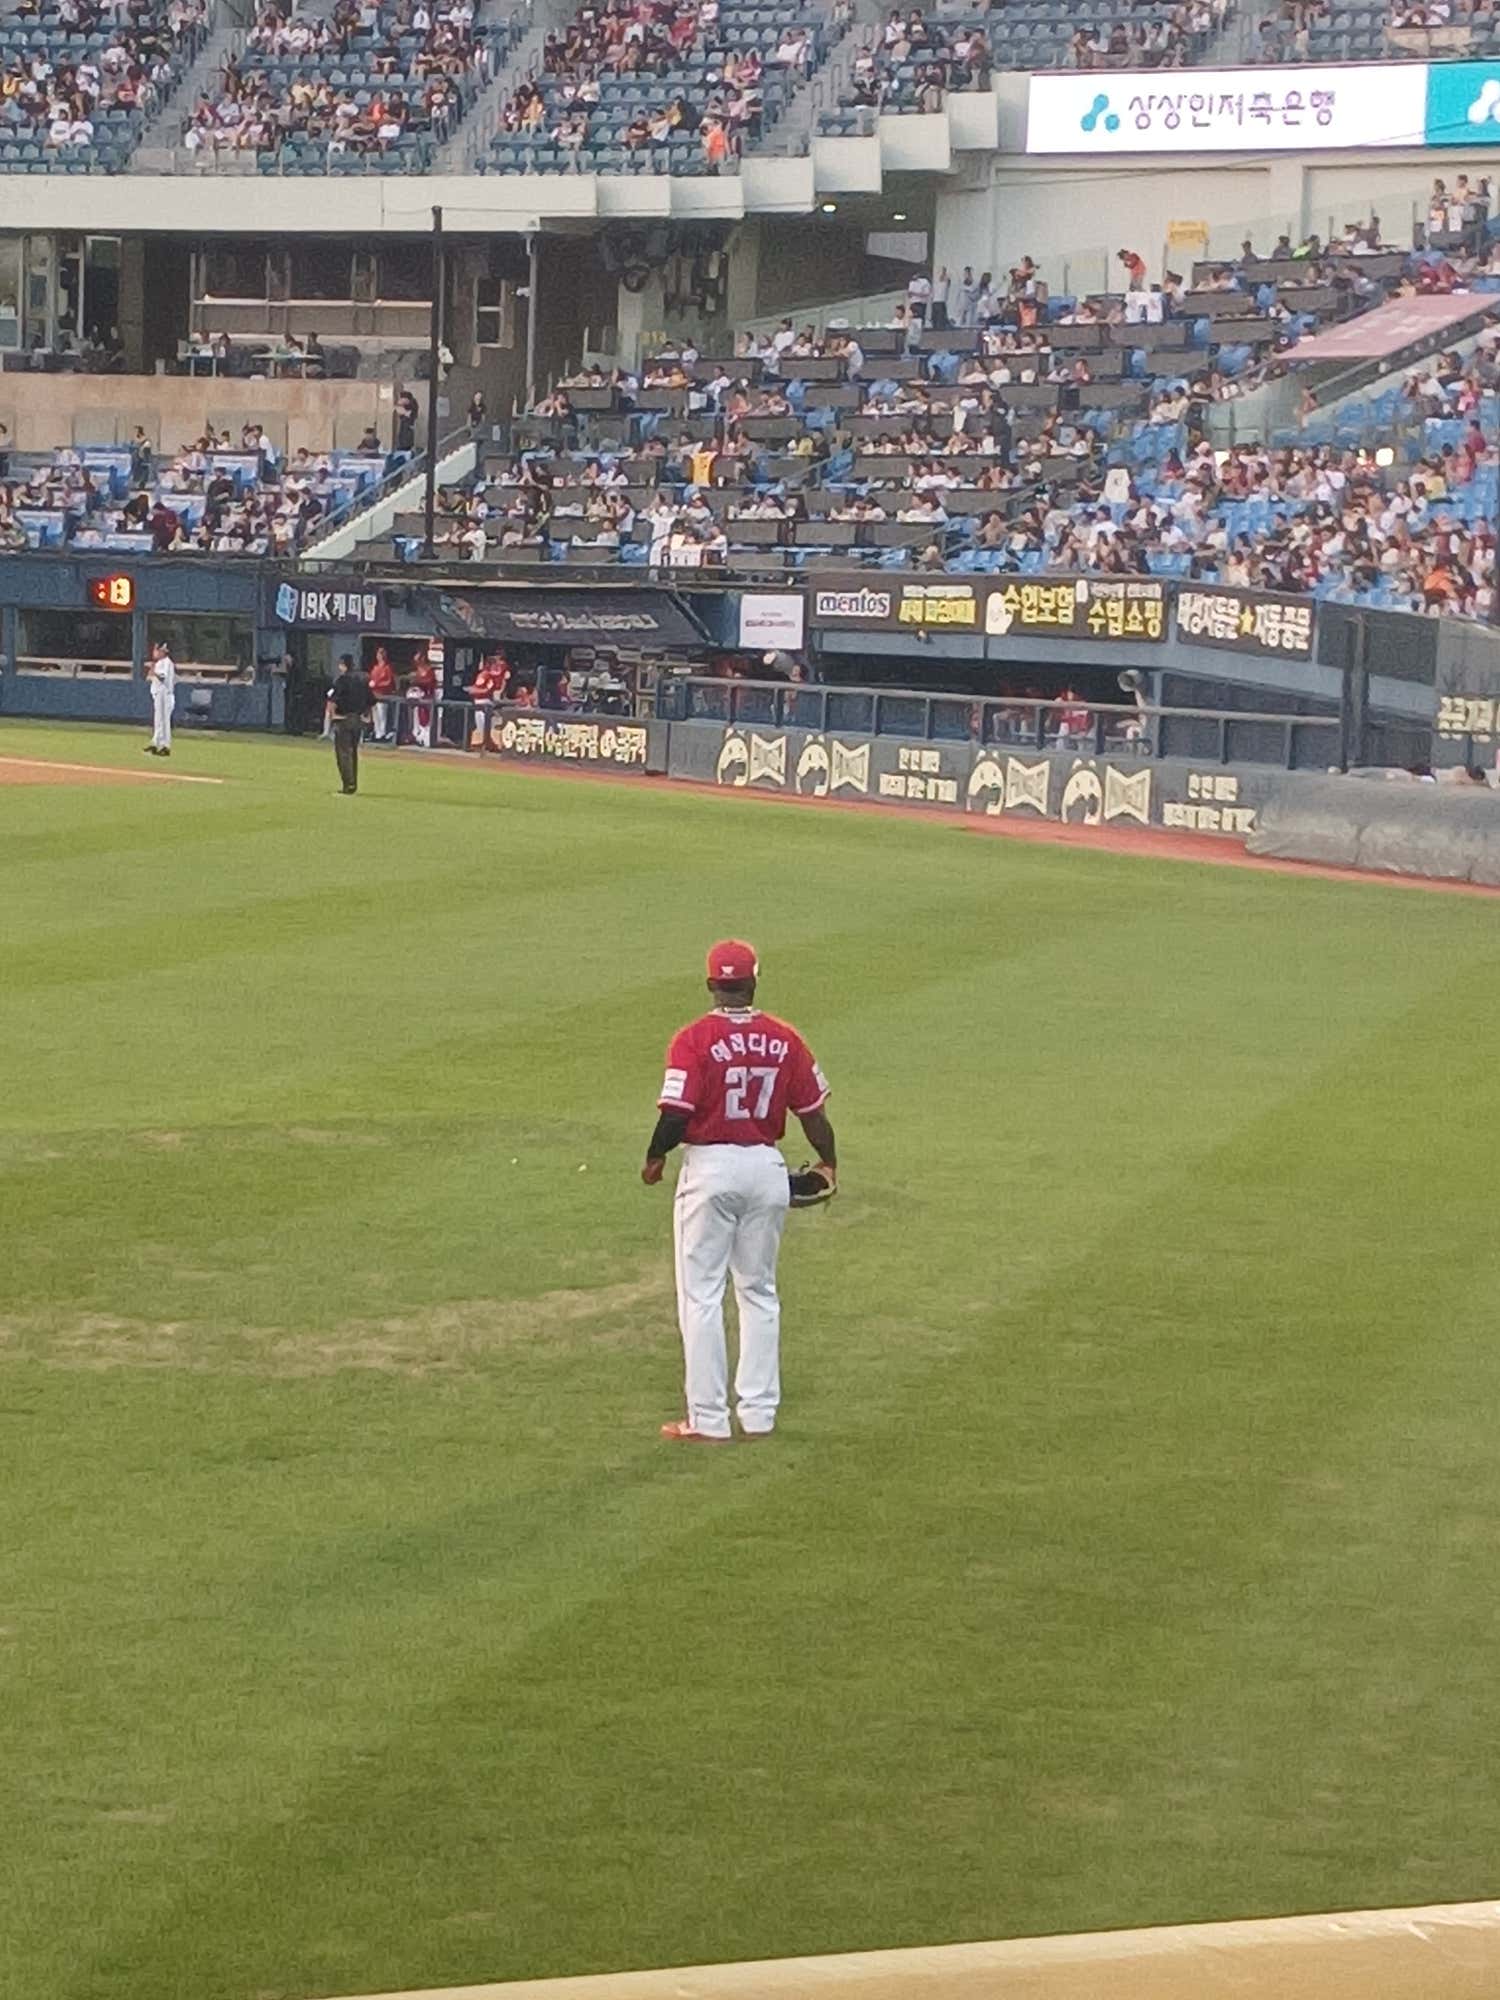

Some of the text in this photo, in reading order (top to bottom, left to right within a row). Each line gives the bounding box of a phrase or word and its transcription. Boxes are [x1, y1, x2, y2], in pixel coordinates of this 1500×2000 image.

[1128, 90, 1336, 130] 상상인저축은행
[817, 590, 889, 615] mentos
[1003, 584, 1075, 624] 수협보험
[724, 1066, 780, 1120] 27
